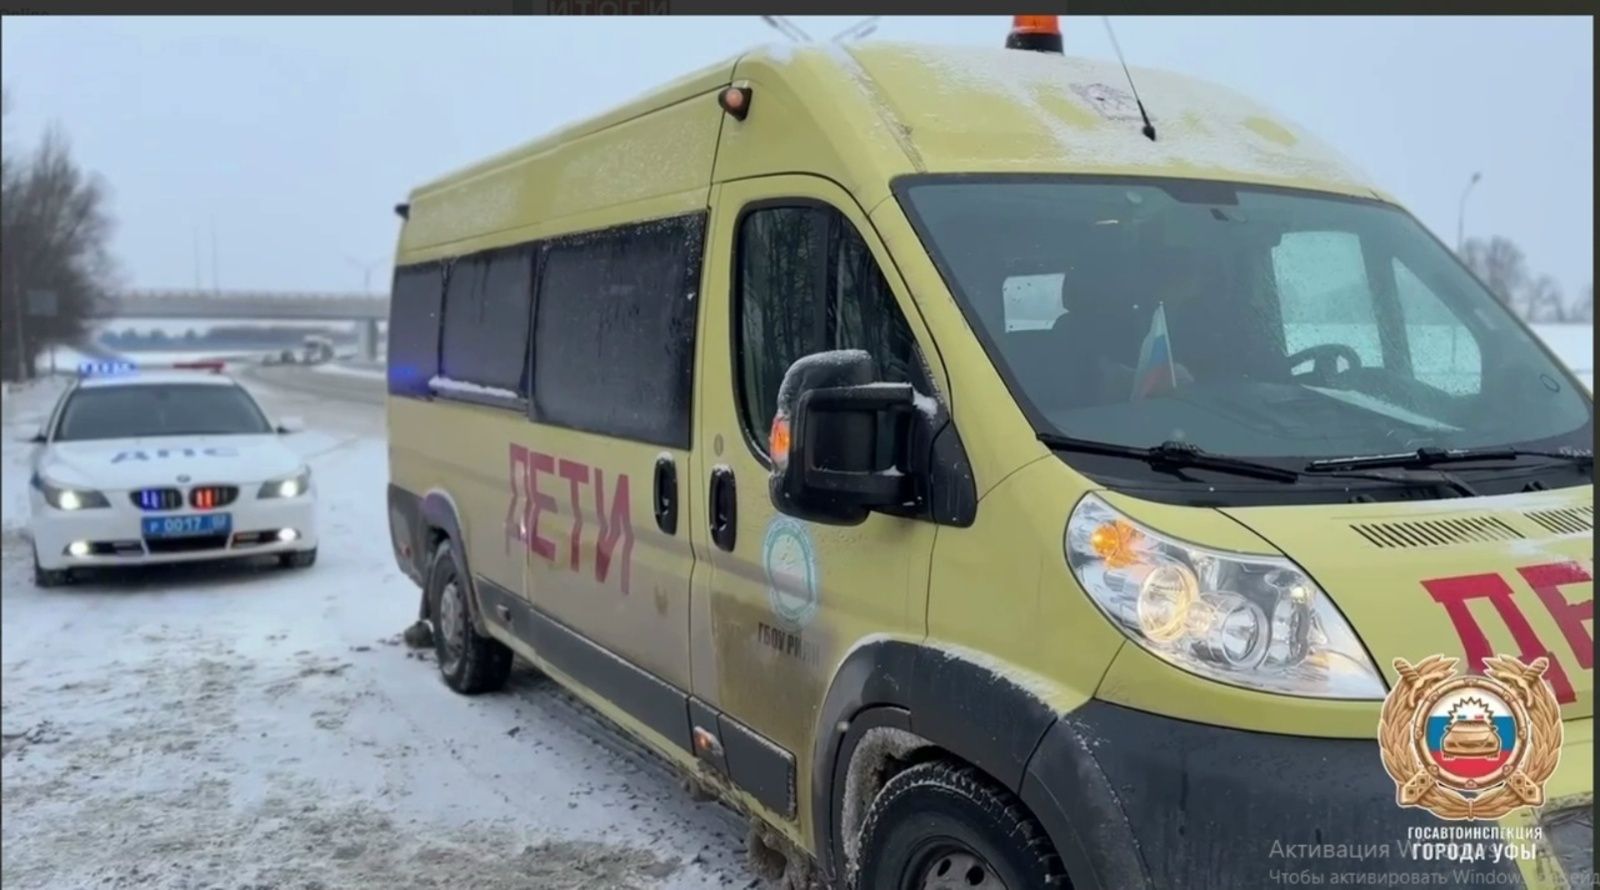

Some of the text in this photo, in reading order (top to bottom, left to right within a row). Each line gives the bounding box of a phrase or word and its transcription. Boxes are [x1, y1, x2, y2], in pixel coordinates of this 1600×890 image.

[110, 448, 240, 464] ДПС
[505, 442, 635, 596] ДЕТИ
[758, 622, 786, 651] ГБОУ
